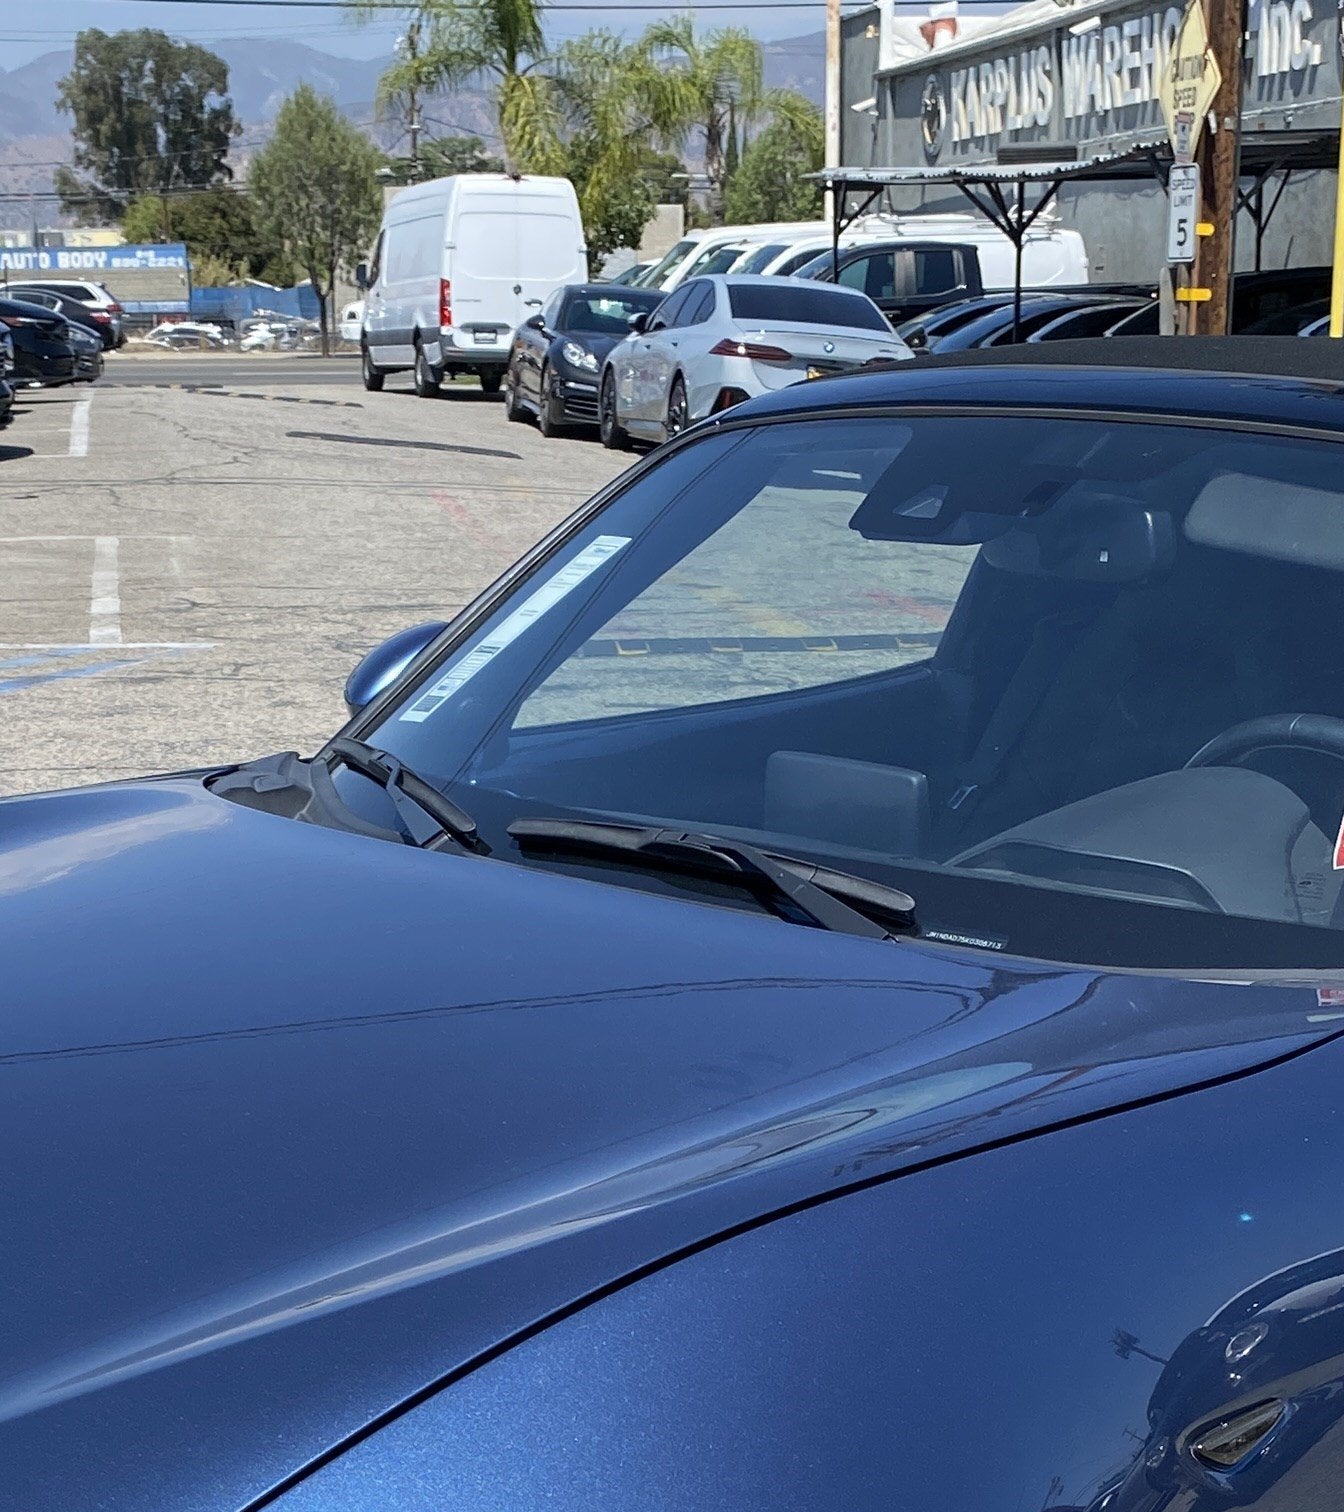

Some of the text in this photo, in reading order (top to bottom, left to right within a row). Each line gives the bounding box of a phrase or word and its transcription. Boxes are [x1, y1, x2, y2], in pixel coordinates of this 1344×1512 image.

[950, 45, 1054, 142] KARPLUS
[1171, 178, 1195, 191] SPEED
[1173, 194, 1193, 208] LIMIT
[1176, 218, 1188, 247] 5
[0, 252, 51, 270] AUTO
[58, 251, 107, 269] BODY
